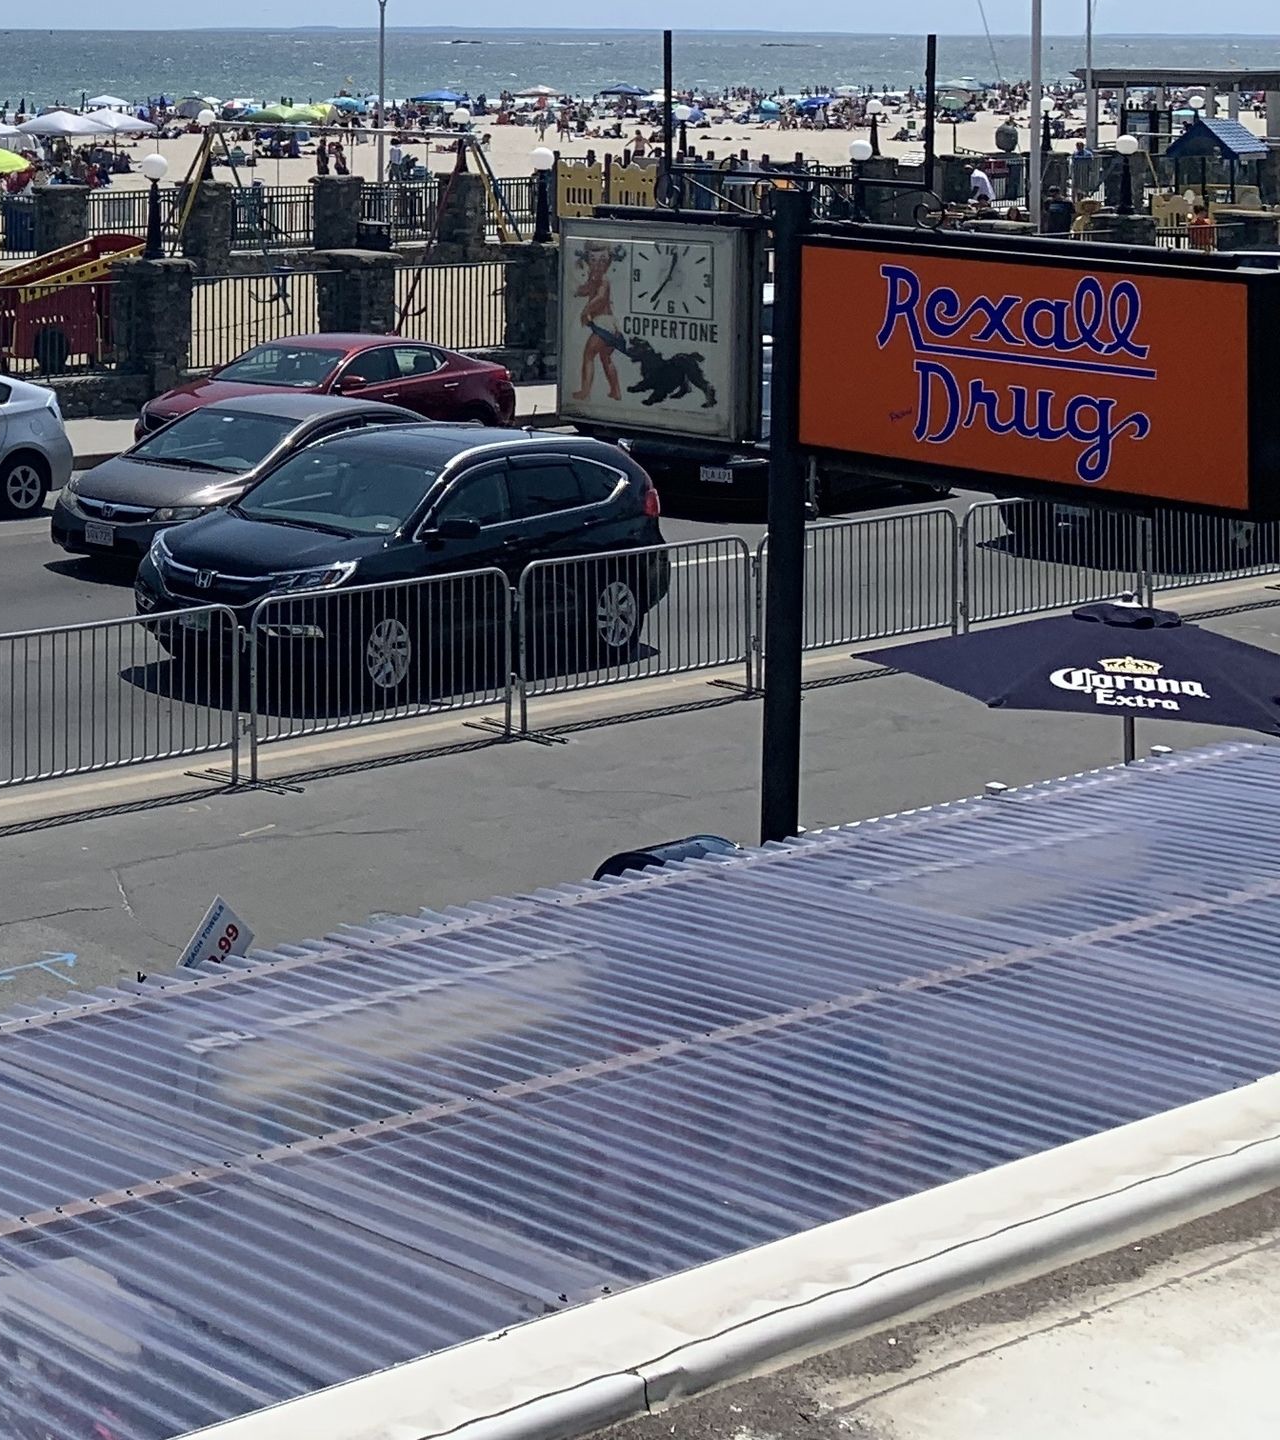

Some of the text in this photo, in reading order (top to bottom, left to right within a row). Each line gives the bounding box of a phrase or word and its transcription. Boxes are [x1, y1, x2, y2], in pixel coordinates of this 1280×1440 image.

[665, 245, 679, 257] 12
[633, 269, 640, 283] 9
[703, 274, 712, 289] 3
[667, 300, 675, 313] 6
[876, 264, 1150, 360] Rexall
[623, 316, 719, 343] COPPERTONE
[913, 360, 1151, 482] Drug
[1049, 667, 1211, 699] Corona
[1094, 689, 1181, 711] Extra
[201, 904, 225, 940] TOWELS
